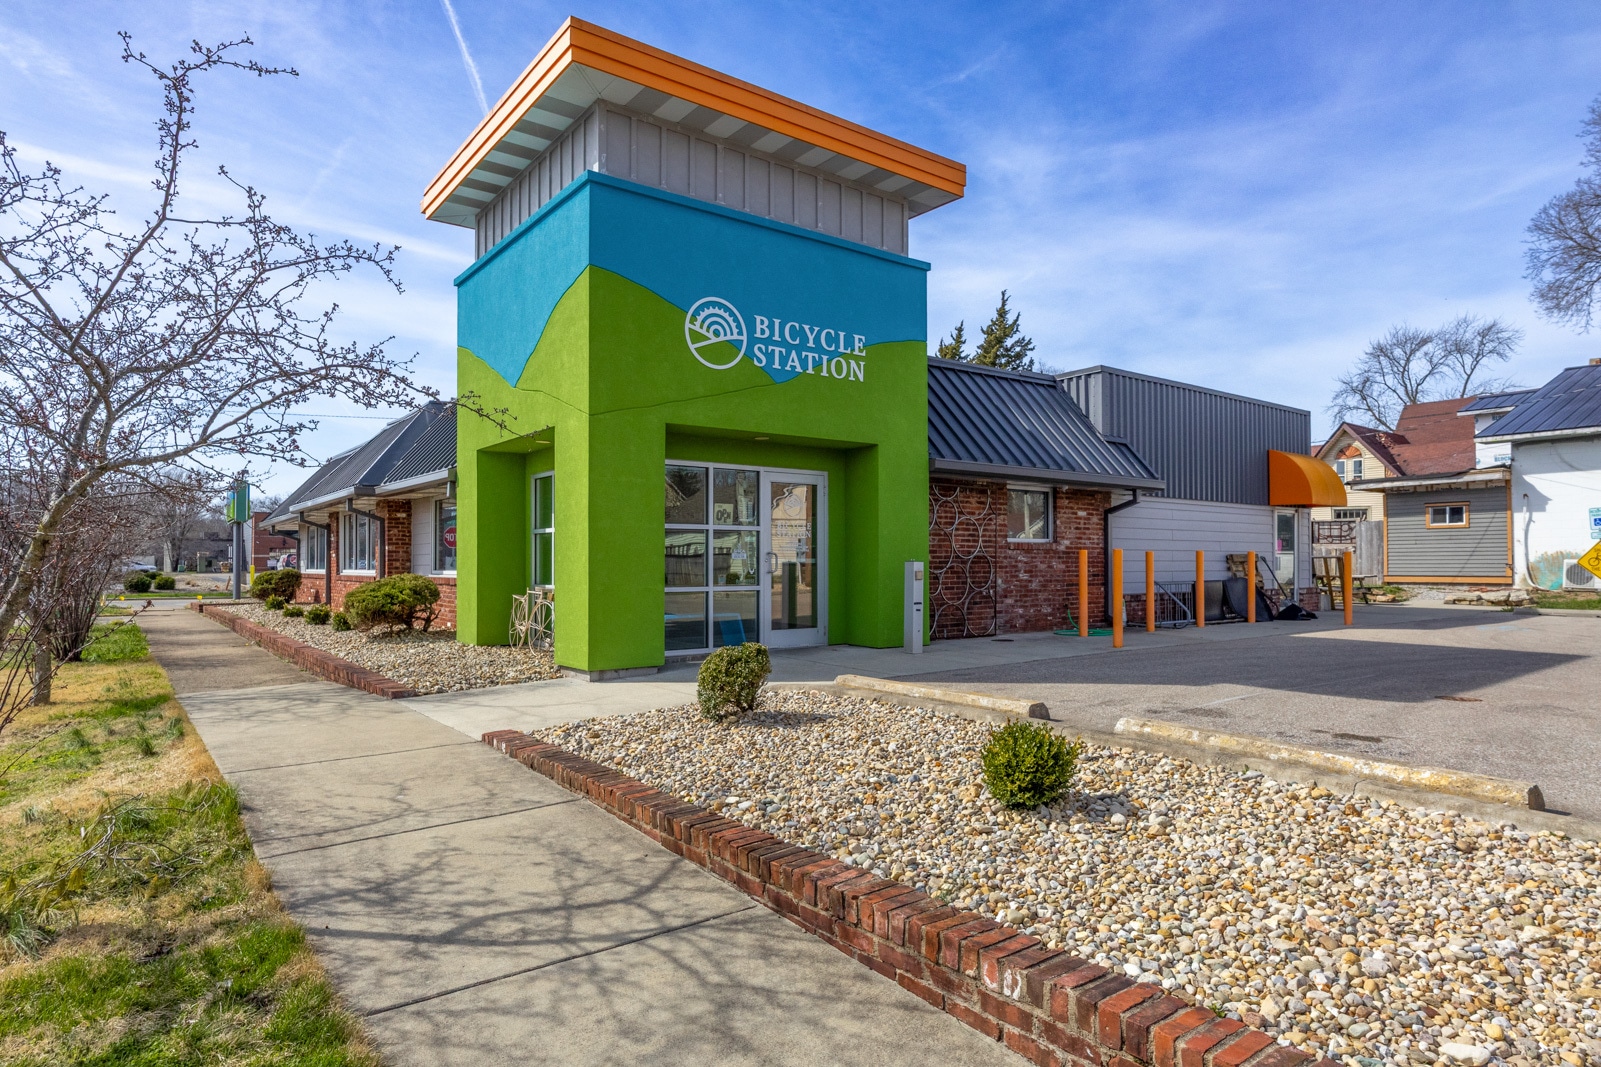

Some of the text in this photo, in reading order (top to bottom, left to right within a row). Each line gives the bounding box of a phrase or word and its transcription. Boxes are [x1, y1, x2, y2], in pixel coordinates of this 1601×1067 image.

[753, 314, 866, 356] BICYCLE
[753, 343, 866, 382] STATION
[716, 508, 731, 523] OPEN
